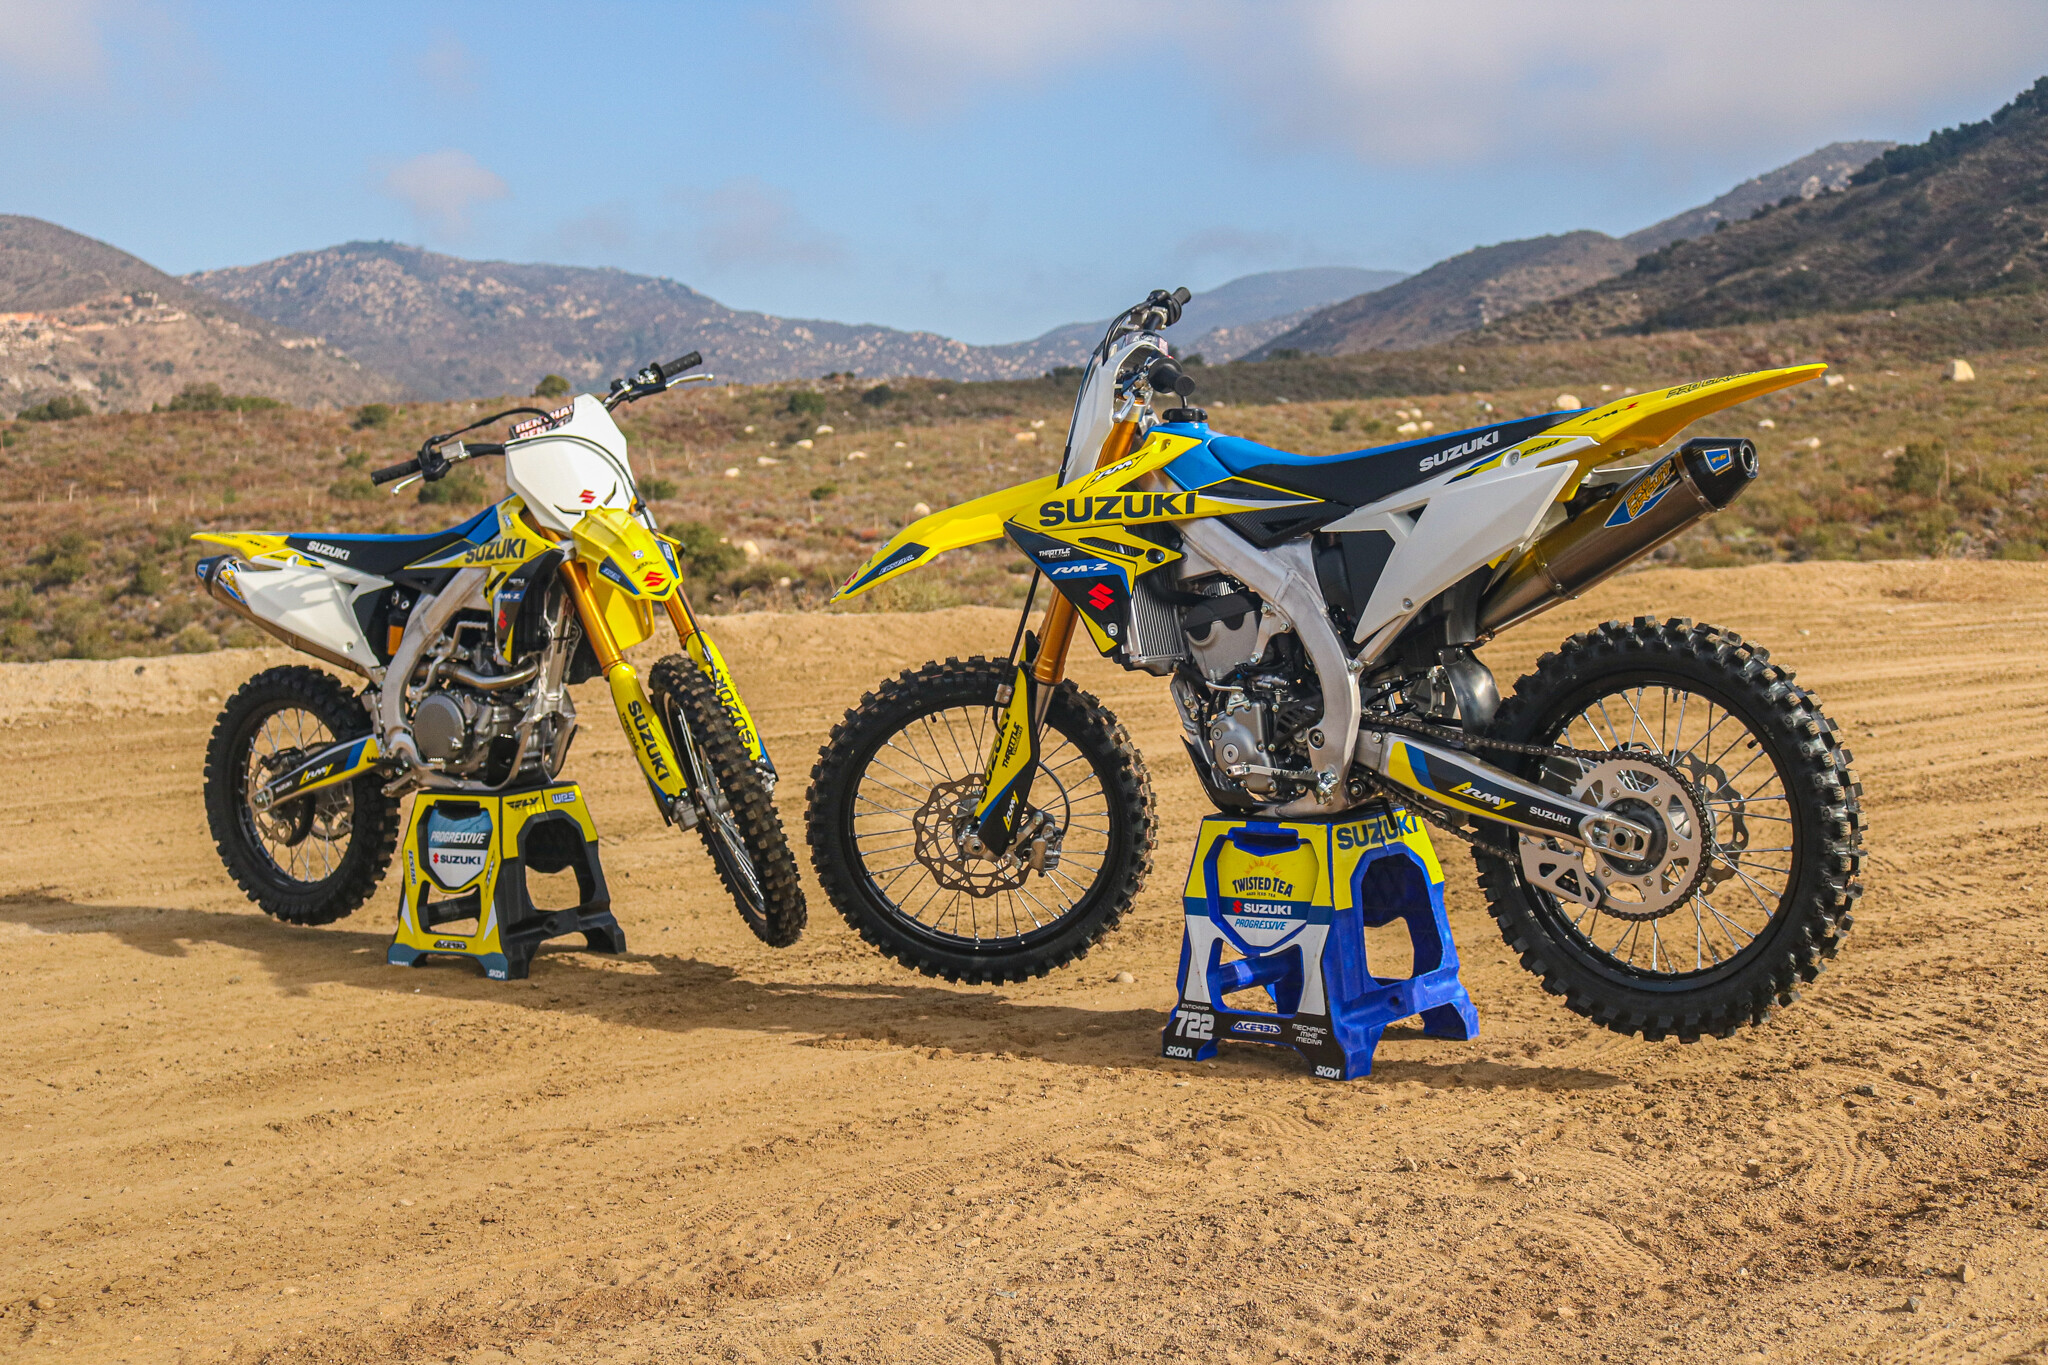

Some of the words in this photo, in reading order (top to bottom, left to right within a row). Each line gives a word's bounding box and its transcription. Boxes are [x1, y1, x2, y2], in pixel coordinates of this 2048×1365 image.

[1419, 430, 1499, 472] SUZUKI
[1627, 474, 1652, 509] PRO
[1629, 461, 1672, 518] CIRCUIT
[1039, 492, 1197, 527] SUZUKI
[306, 540, 350, 561] SUZUKI
[464, 538, 527, 564] SUZUKI
[1038, 547, 1072, 558] THROTTLE
[1052, 562, 1109, 575] RM-Z
[628, 700, 671, 782] SUZUKI
[1001, 721, 1021, 769] THROTTLE
[551, 791, 576, 804] WPS
[1529, 806, 1572, 825] SUZUKI
[430, 830, 487, 845] PROGRESSIVE
[1336, 815, 1418, 850] SUZUKI
[440, 854, 482, 866] SUZUKI
[1232, 876, 1272, 894] TWISTED
[1272, 876, 1294, 898] TEA
[1243, 903, 1292, 915] SUZUKI
[1234, 918, 1287, 931] PROGRESSIVE
[1175, 1010, 1215, 1040] 722
[1233, 1021, 1282, 1035] ACERBIS
[1295, 1037, 1323, 1046] MEDINA
[1299, 1031, 1319, 1039] MIKE
[1165, 1046, 1193, 1058] SKDA
[1315, 1065, 1341, 1079] SKDA
